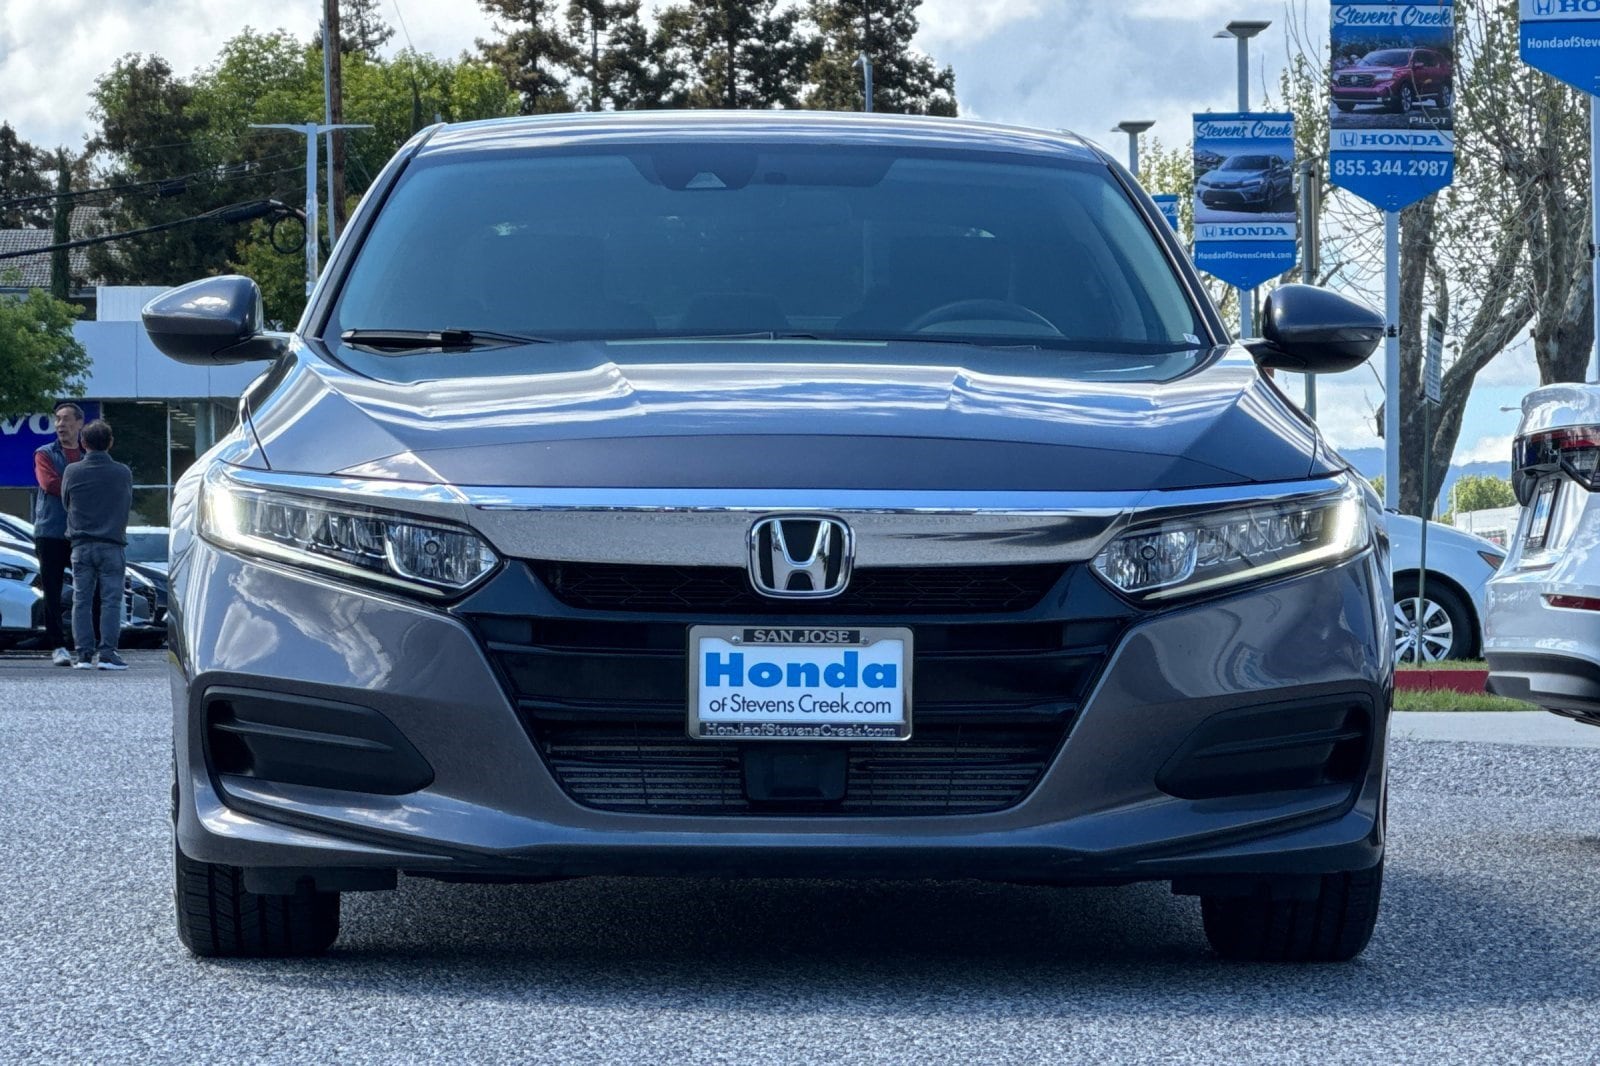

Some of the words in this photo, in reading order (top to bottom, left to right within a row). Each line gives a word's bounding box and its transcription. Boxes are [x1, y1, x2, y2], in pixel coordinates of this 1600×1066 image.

[1334, 5, 1397, 26] Stevens
[1400, 5, 1451, 26] Creek
[1409, 116, 1449, 124] PILOT
[1197, 120, 1248, 139] Stevens
[1251, 120, 1292, 138] Creek
[1360, 133, 1444, 146] HONDA
[1335, 160, 1449, 176] 855.344.2987
[1220, 226, 1288, 236] HONDA
[1198, 251, 1292, 260] HondaofStevensCreek.com
[753, 630, 793, 643] SAN
[799, 630, 850, 643] JOSE
[705, 651, 897, 688] Honda
[709, 697, 727, 713] of
[729, 693, 795, 713] Stevens
[798, 692, 892, 714] Creek.com
